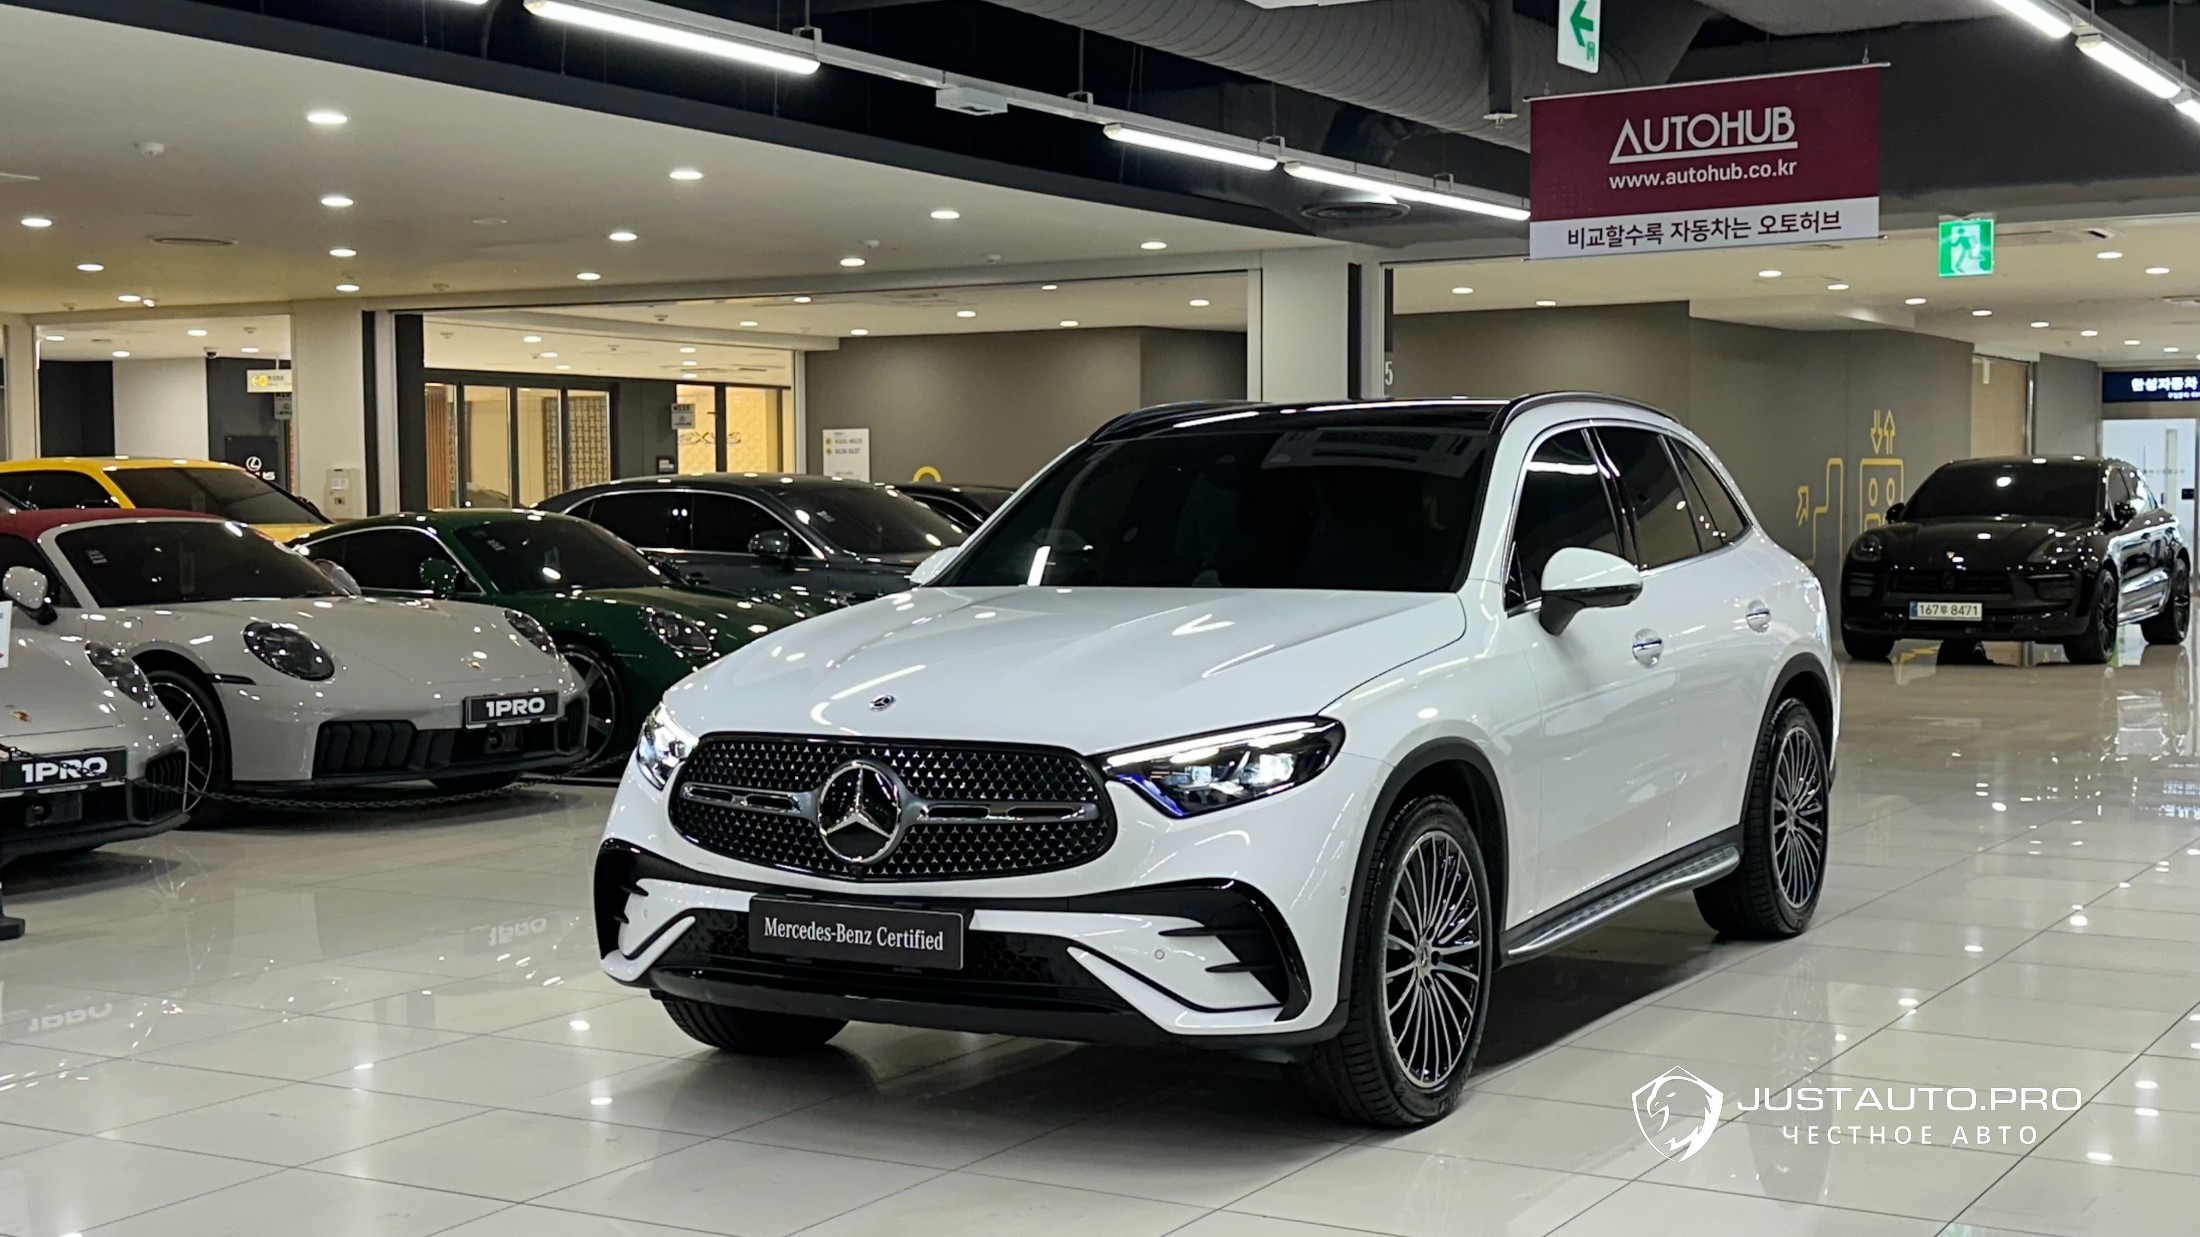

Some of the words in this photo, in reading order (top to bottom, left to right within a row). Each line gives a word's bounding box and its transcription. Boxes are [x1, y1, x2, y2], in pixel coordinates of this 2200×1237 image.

[1609, 106, 1798, 164] AUTOHUB
[1609, 159, 1797, 189] www.autohub.co.kr
[1567, 221, 1664, 249] 비교할수록
[1670, 216, 1751, 244] 자동차는
[1757, 210, 1842, 236] 오토허브
[1950, 604, 1978, 616] 8471
[485, 697, 545, 717] 1PRO
[21, 757, 108, 783] 1PRO
[764, 917, 872, 946] Mercedes-Benz
[876, 926, 944, 951] Certified
